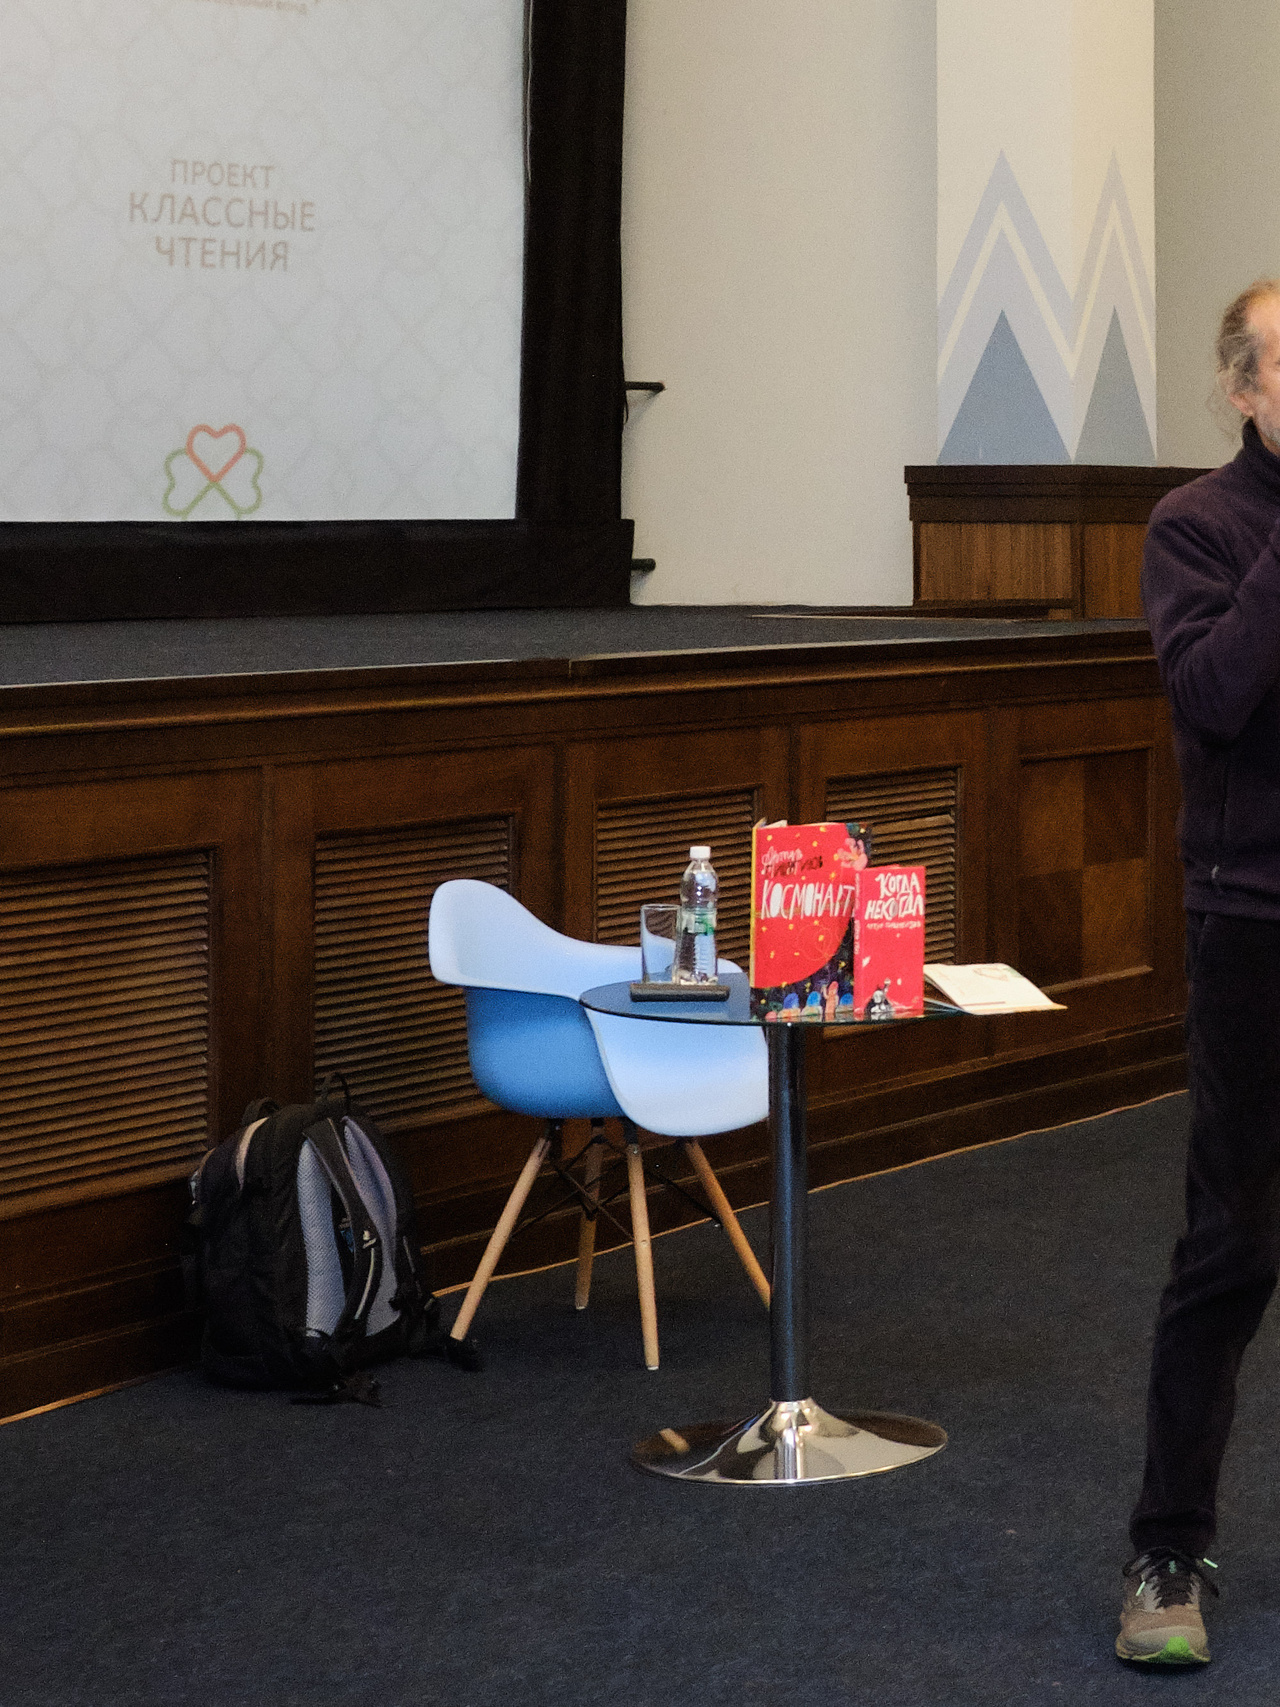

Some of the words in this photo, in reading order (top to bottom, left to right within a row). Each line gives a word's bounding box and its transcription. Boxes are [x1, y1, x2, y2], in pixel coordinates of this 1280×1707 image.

[171, 159, 275, 188] ПРОЕКТ
[129, 192, 315, 232] КЛАССНЫЕ
[155, 237, 289, 271] ЧТЕНИЯ
[761, 880, 855, 919] КОСМОНАВТ
[875, 872, 921, 899] КОГДА
[864, 894, 924, 920] НЕКОГДА
